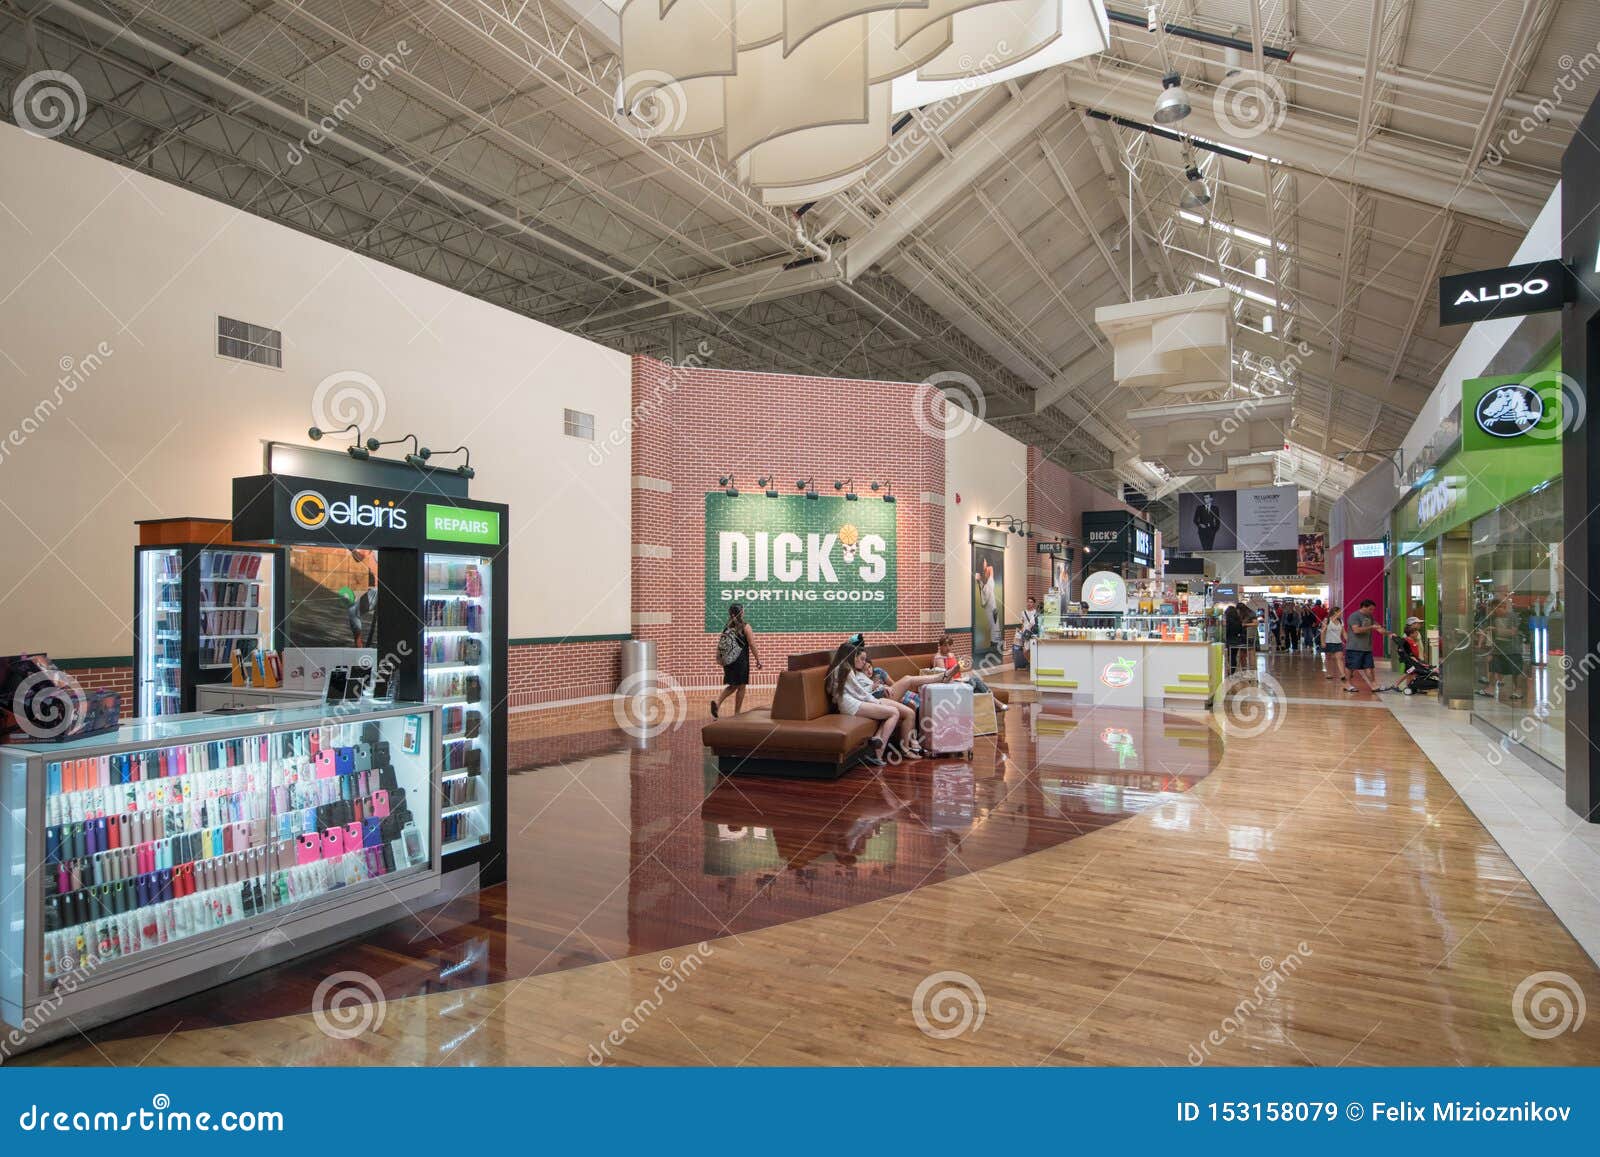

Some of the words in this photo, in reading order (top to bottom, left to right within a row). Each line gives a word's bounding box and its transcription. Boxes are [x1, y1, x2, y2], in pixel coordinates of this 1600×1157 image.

[1453, 278, 1549, 306] ALDO
[291, 490, 407, 531] Cellairis
[434, 517, 489, 535] REPAIRS
[1090, 531, 1118, 540] DICK'S
[719, 525, 886, 583] DICK'S
[721, 589, 818, 601] SPORTING
[823, 590, 885, 601] GOODS
